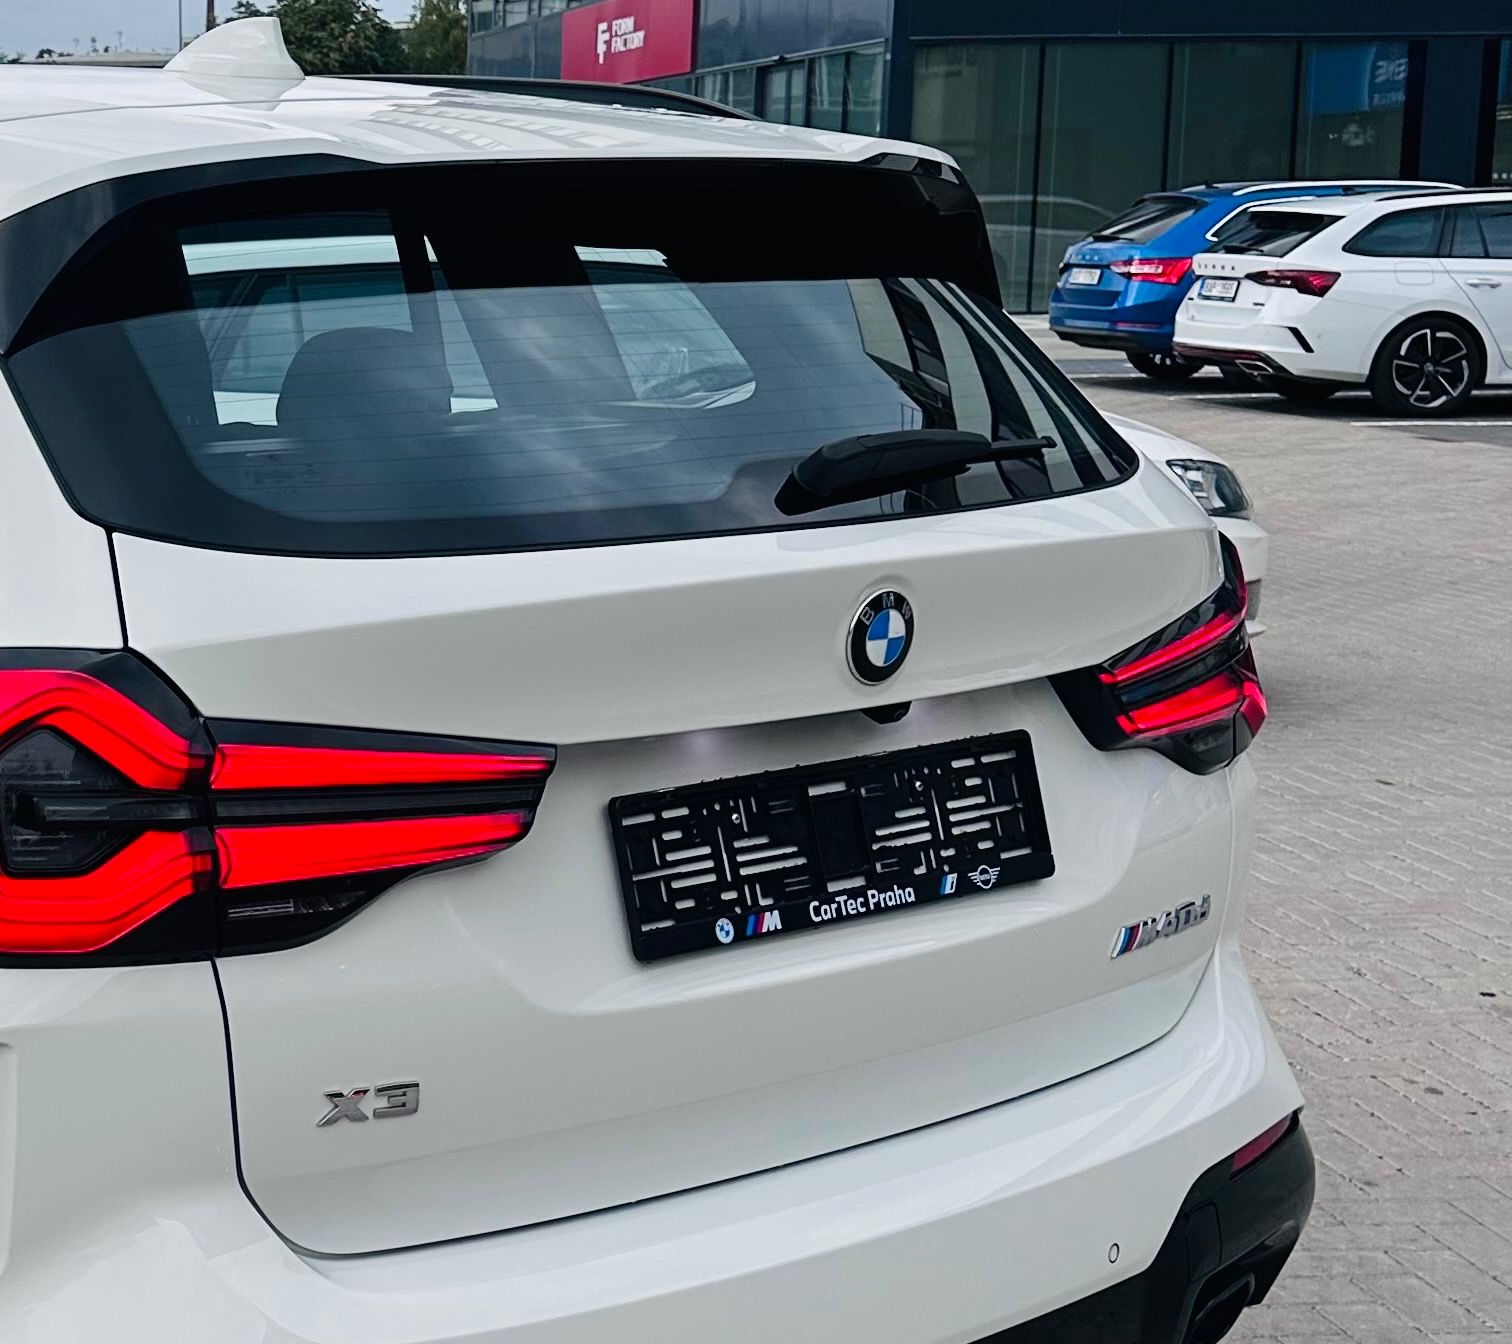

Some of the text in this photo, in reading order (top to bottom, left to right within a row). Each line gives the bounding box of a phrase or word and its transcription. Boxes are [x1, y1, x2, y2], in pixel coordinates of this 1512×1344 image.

[610, 29, 646, 54] FACTORY
[611, 15, 635, 36] FORM
[859, 592, 912, 625] BMW
[808, 895, 865, 923] CarTec
[866, 884, 916, 910] Praha
[315, 1080, 420, 1127] X3
